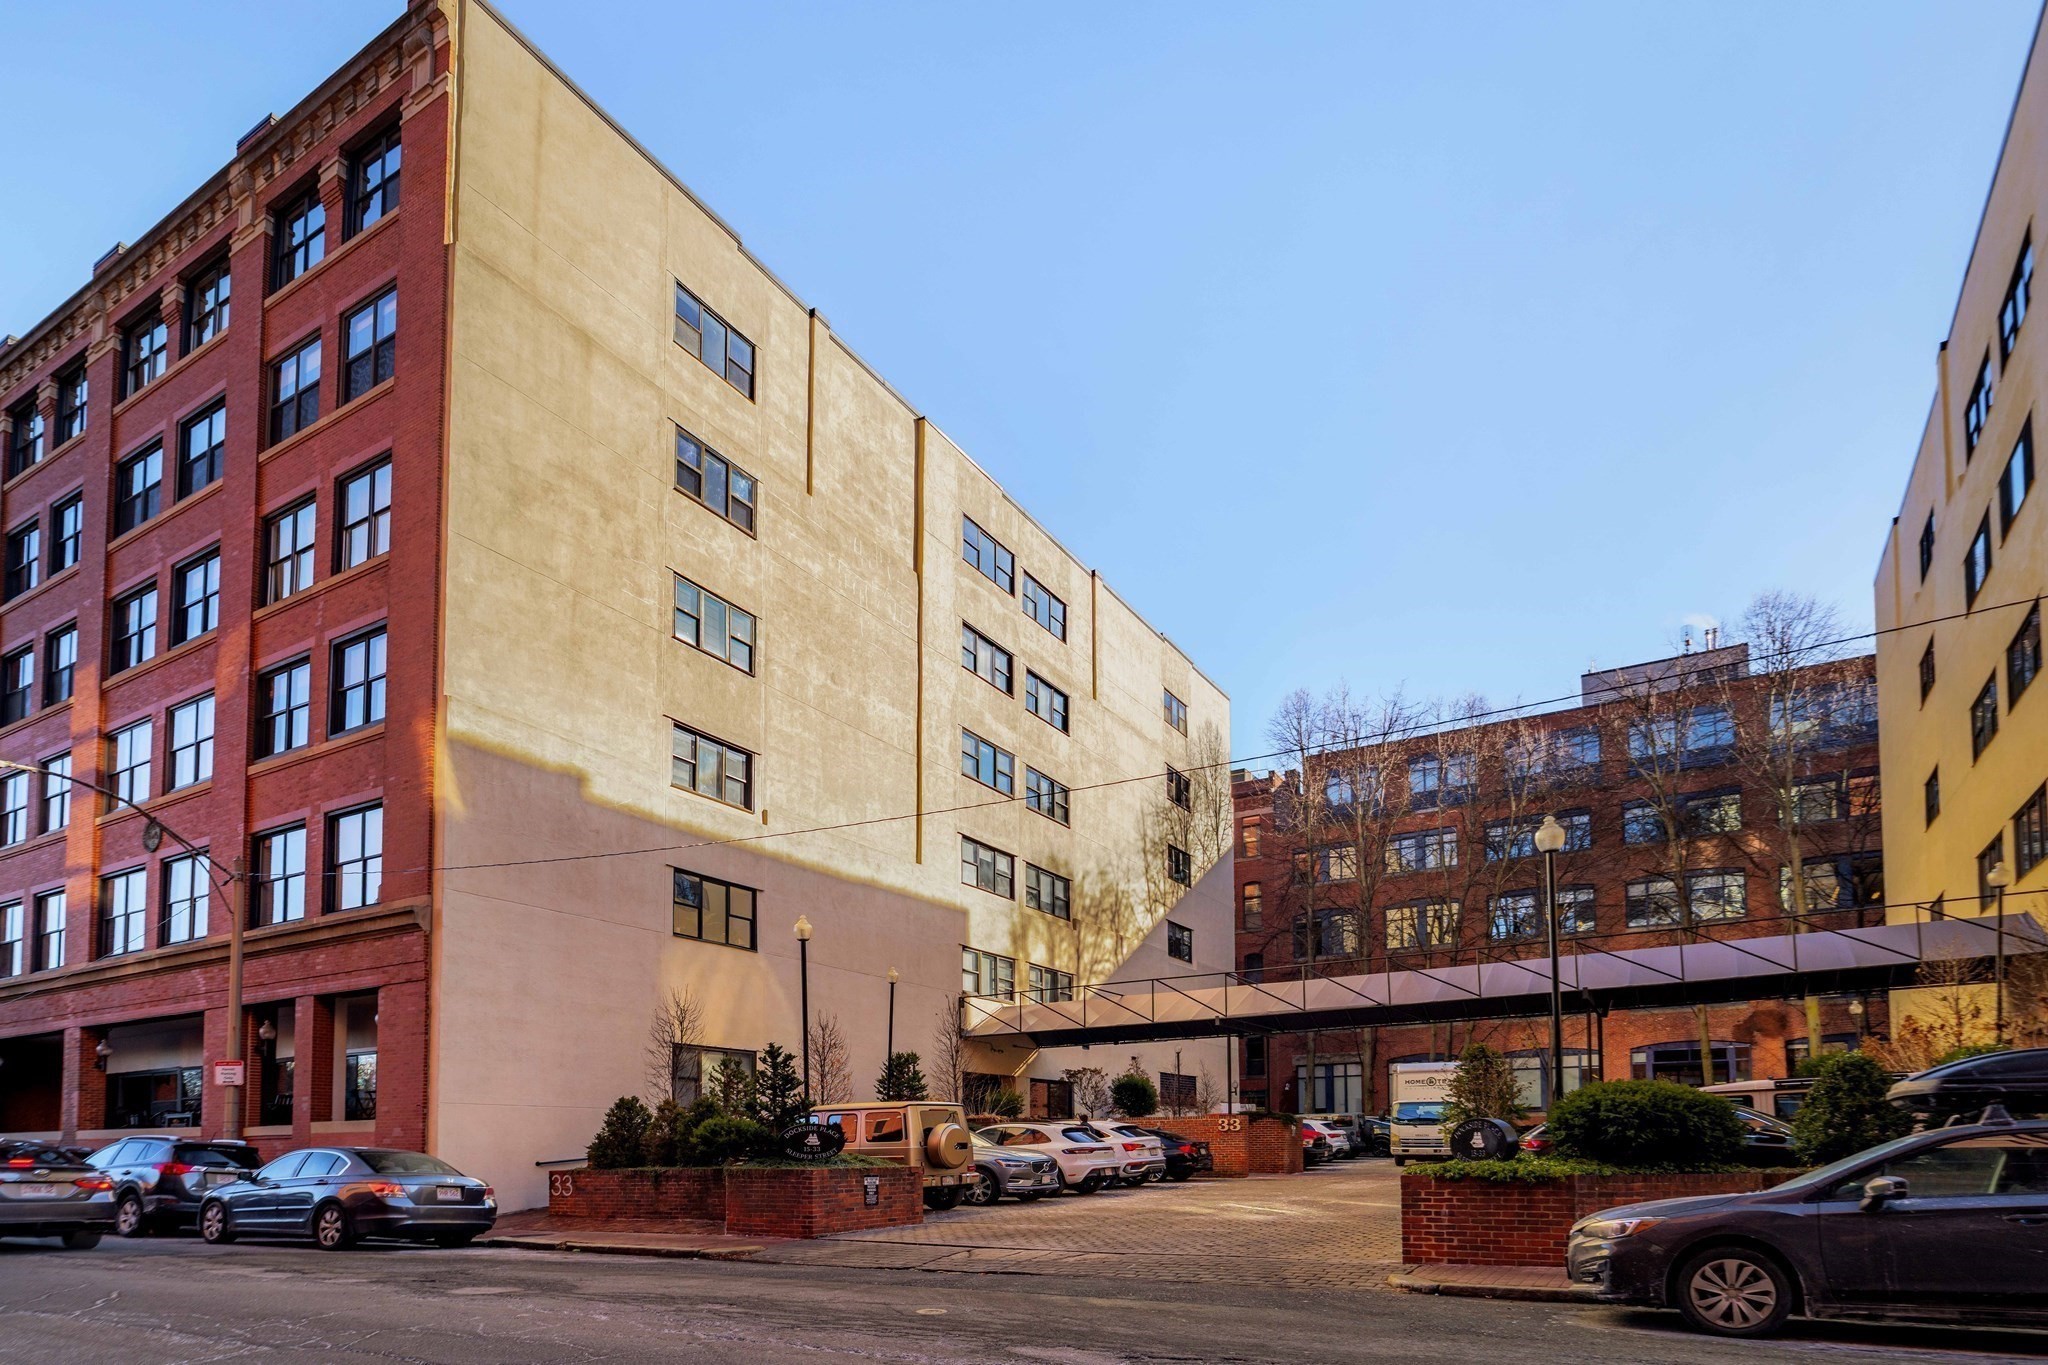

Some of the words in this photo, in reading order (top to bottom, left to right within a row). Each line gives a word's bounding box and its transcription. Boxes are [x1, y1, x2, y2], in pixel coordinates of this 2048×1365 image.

[1218, 1118, 1241, 1131] 33
[783, 1125, 818, 1139] DOCKSIDE
[820, 1126, 841, 1139] PLACE
[785, 1147, 813, 1160] SLEEPER
[814, 1146, 838, 1160] STREET
[551, 1174, 573, 1197] 33
